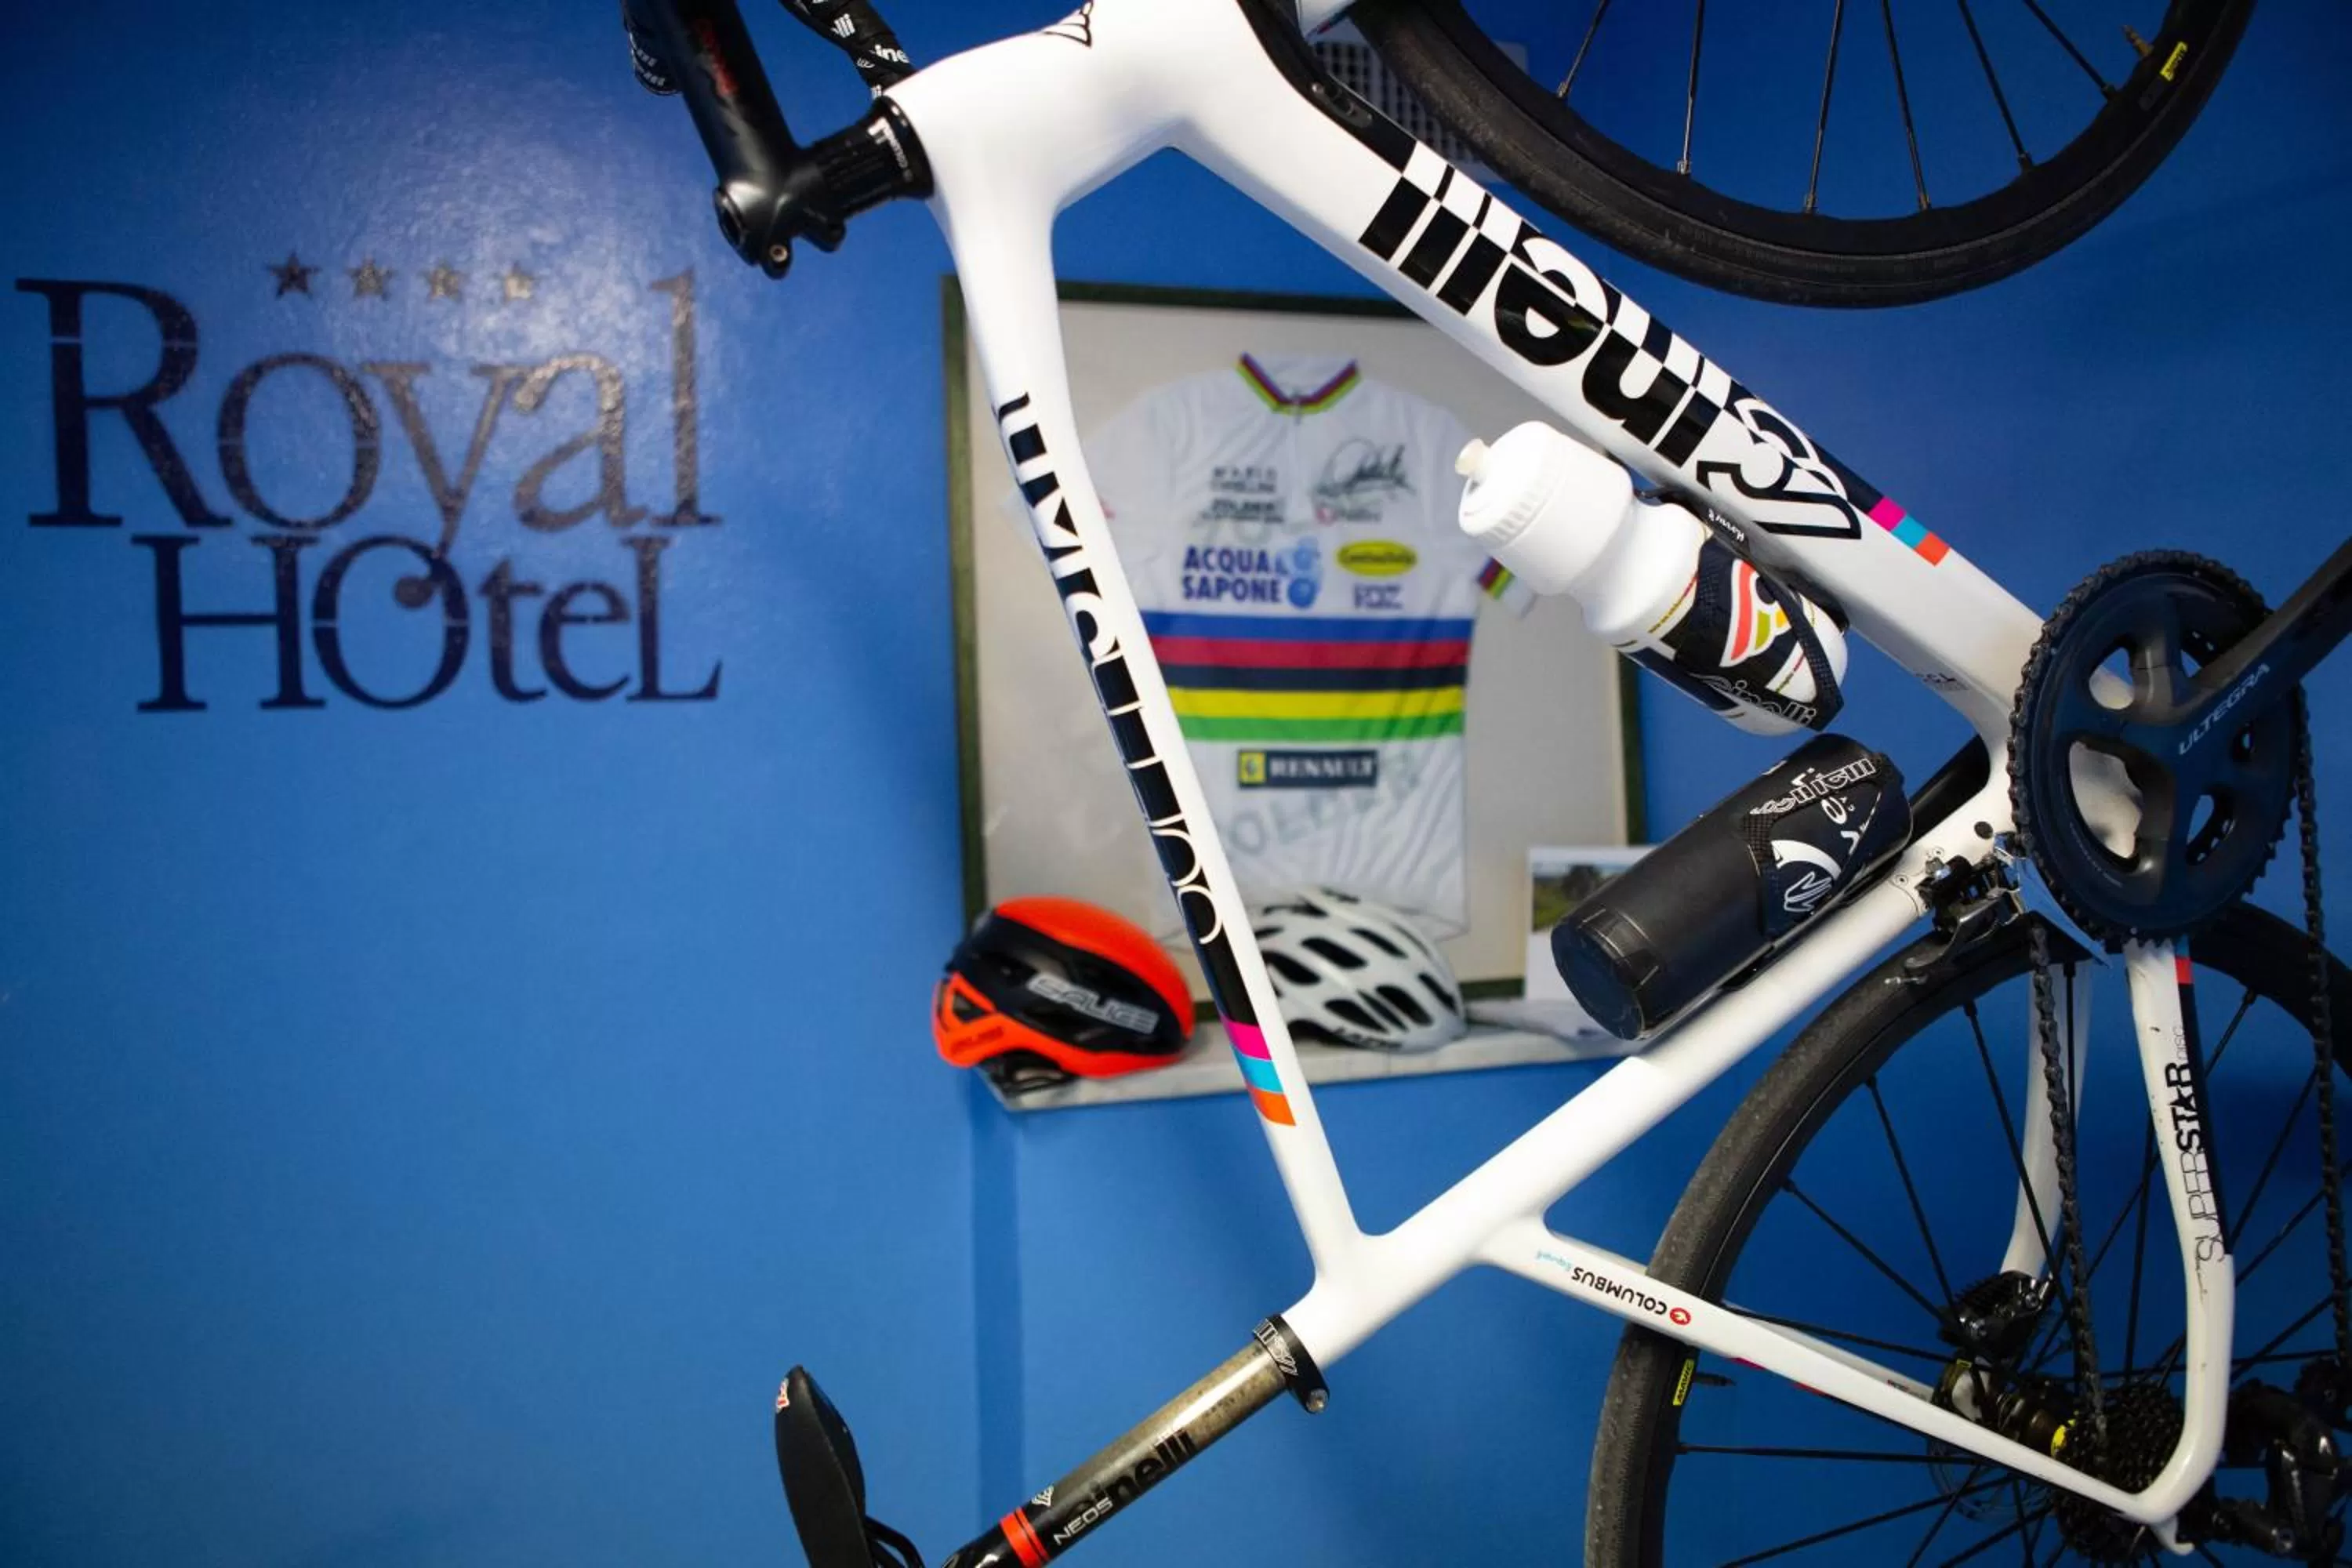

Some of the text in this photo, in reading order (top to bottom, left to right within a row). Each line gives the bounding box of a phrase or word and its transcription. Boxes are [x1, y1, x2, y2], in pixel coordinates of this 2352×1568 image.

[15, 266, 723, 608] Royal
[1184, 545, 1270, 575] ACQUA
[1182, 575, 1281, 603] SAPONE
[2177, 662, 2271, 757] ULTEGRA
[1270, 757, 1373, 777] RENAULT
[1571, 1266, 1668, 1316] COLUMBUS
[1053, 1496, 1114, 1546] NEOS
